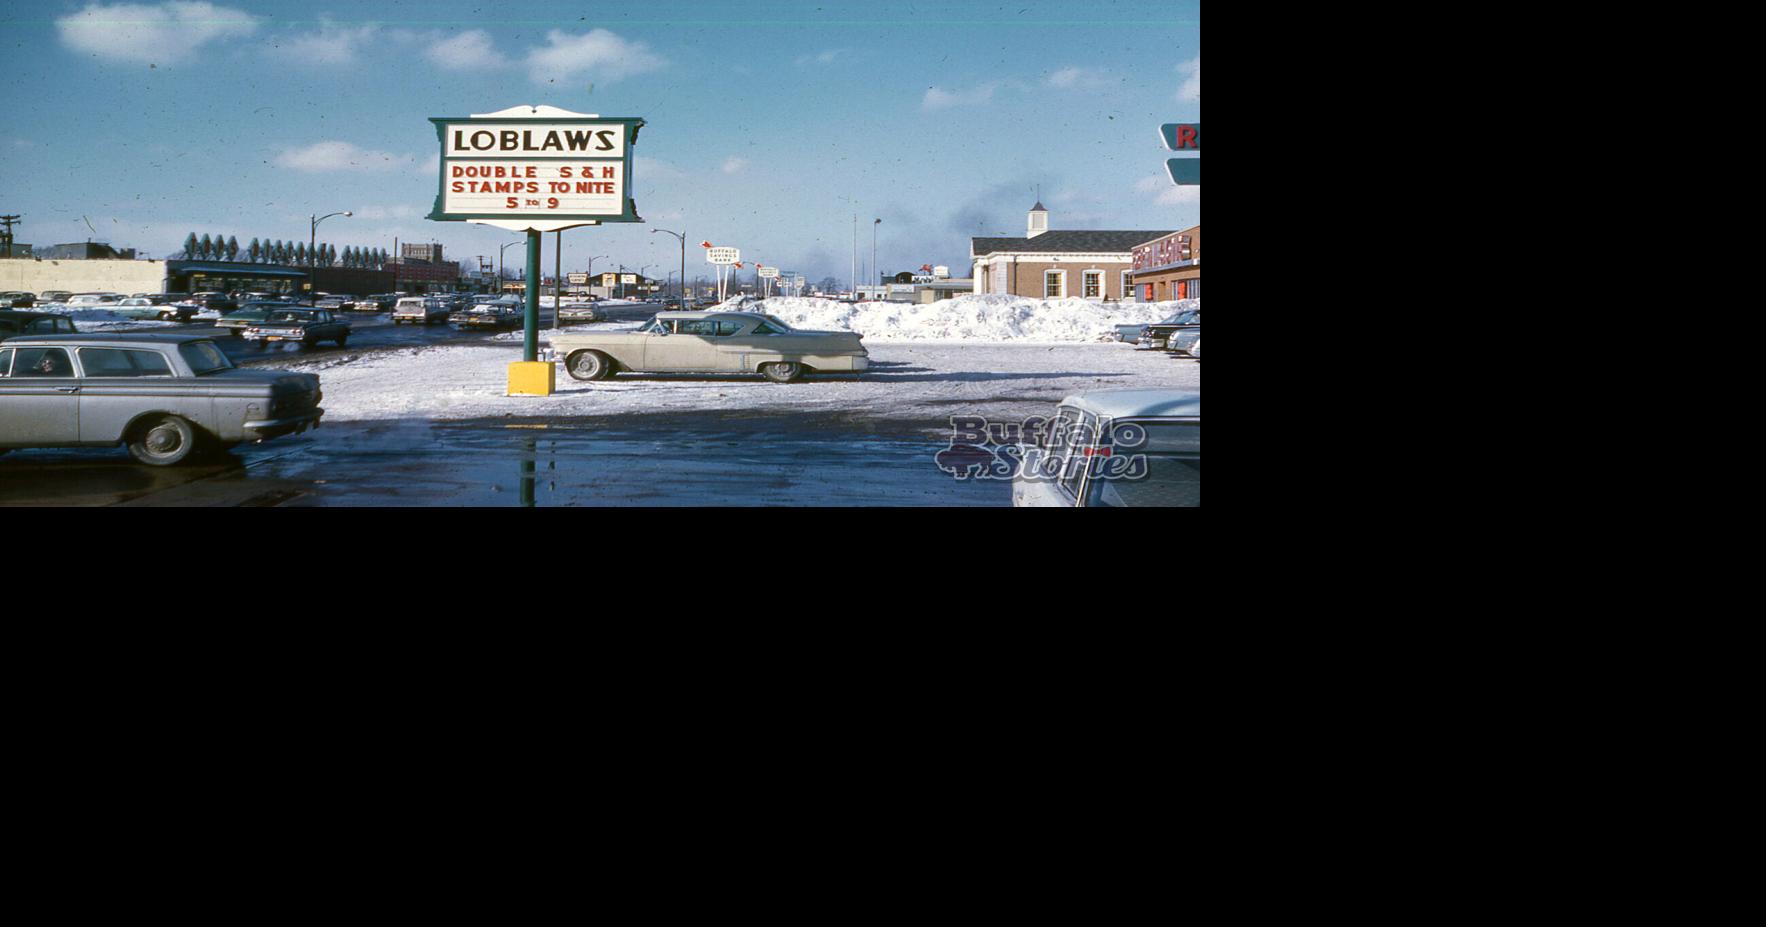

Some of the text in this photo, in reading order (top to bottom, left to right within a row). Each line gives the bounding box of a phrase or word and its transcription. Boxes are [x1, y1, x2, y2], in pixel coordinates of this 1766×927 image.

[454, 130, 616, 151] LOBLAWS
[452, 166, 614, 178] DOUBLE S & H
[452, 181, 615, 193] STAMPS TO NITE
[506, 197, 519, 209] 5
[547, 197, 559, 209] 9
